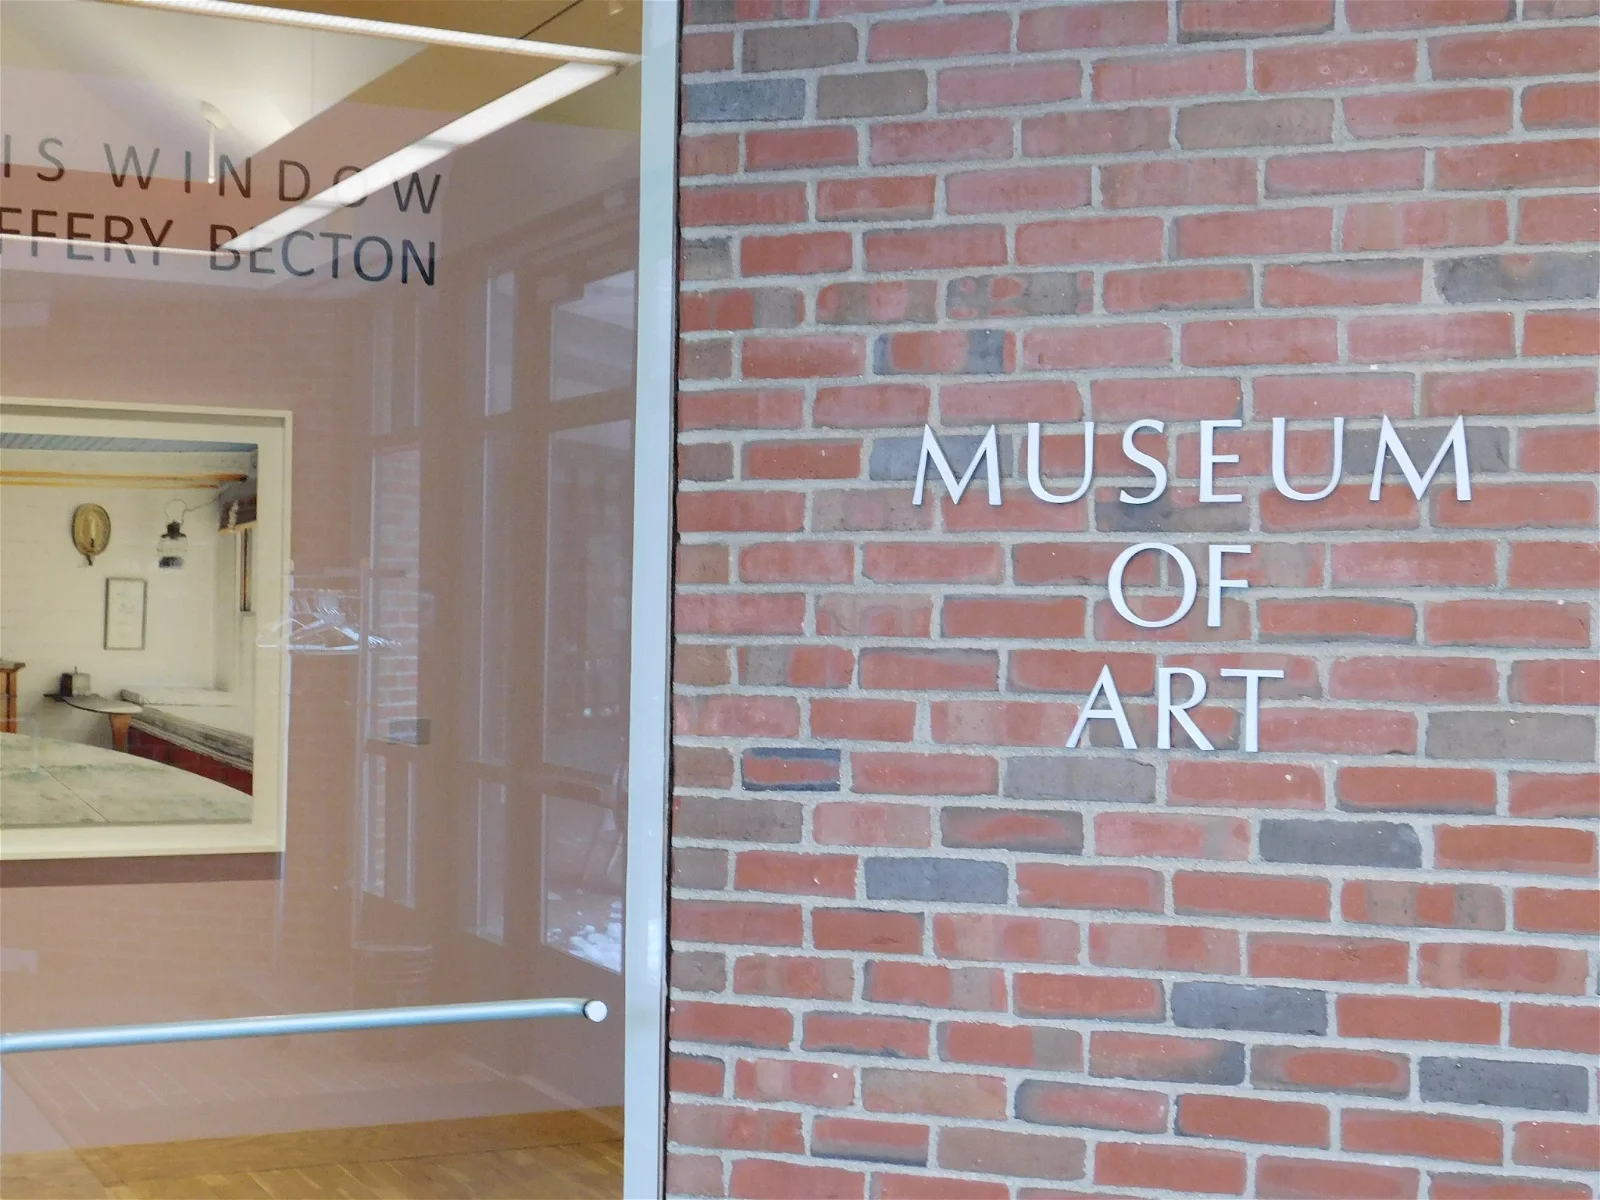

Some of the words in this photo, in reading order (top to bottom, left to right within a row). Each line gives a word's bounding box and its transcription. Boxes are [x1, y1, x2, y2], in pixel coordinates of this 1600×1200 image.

[4, 134, 65, 182] IS
[103, 142, 442, 215] WINDOW
[209, 223, 436, 287] BECTON
[911, 414, 1473, 507] MUSEUM
[1107, 542, 1253, 629] OF
[1065, 664, 1285, 753] ART
